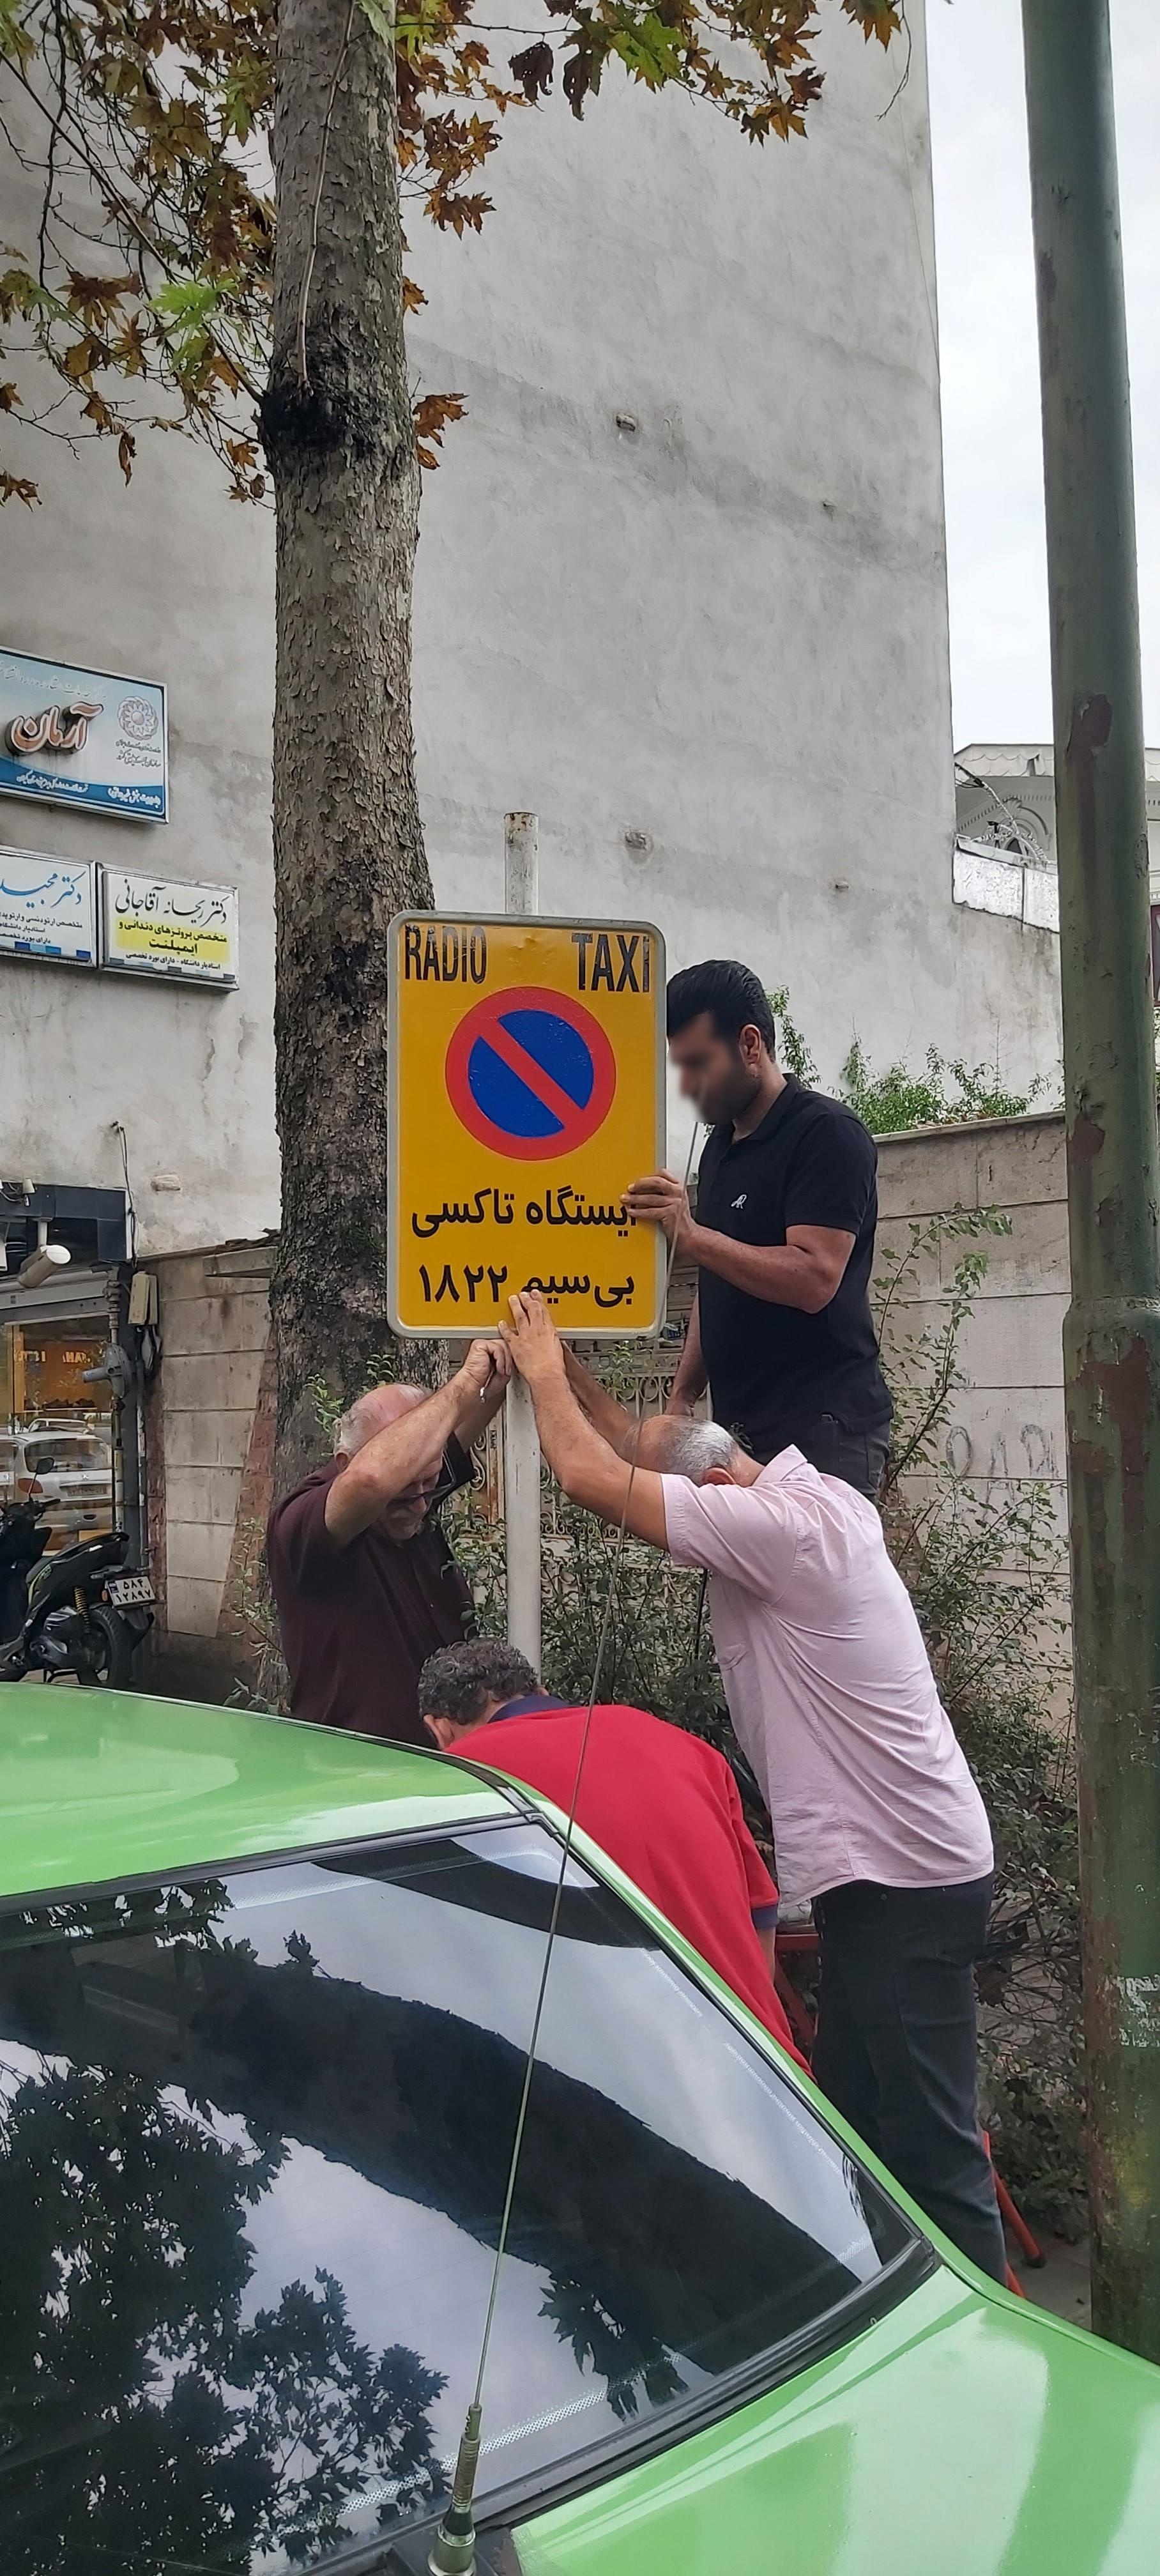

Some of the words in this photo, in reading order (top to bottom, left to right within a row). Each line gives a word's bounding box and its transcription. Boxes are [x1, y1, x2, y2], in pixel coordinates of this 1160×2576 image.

[8, 702, 104, 755] آرمان
[50, 870, 86, 908] دکتر
[115, 878, 166, 917] آقاجانی
[0, 912, 20, 921] ارتوپد
[56, 920, 83, 928] متخصص
[164, 899, 205, 924] ریحانه
[200, 896, 230, 927] دکتر
[119, 921, 123, 929] و
[124, 921, 153, 931] دندانی
[194, 933, 227, 942] متخصص
[149, 939, 198, 956] ایمپلنت
[404, 924, 487, 983] RADIO
[572, 932, 650, 993] TAXI
[411, 1188, 515, 1238] تاکسی
[418, 1264, 508, 1303] ۱۸۲۲
[123, 1579, 144, 1590] ۵۸۴
